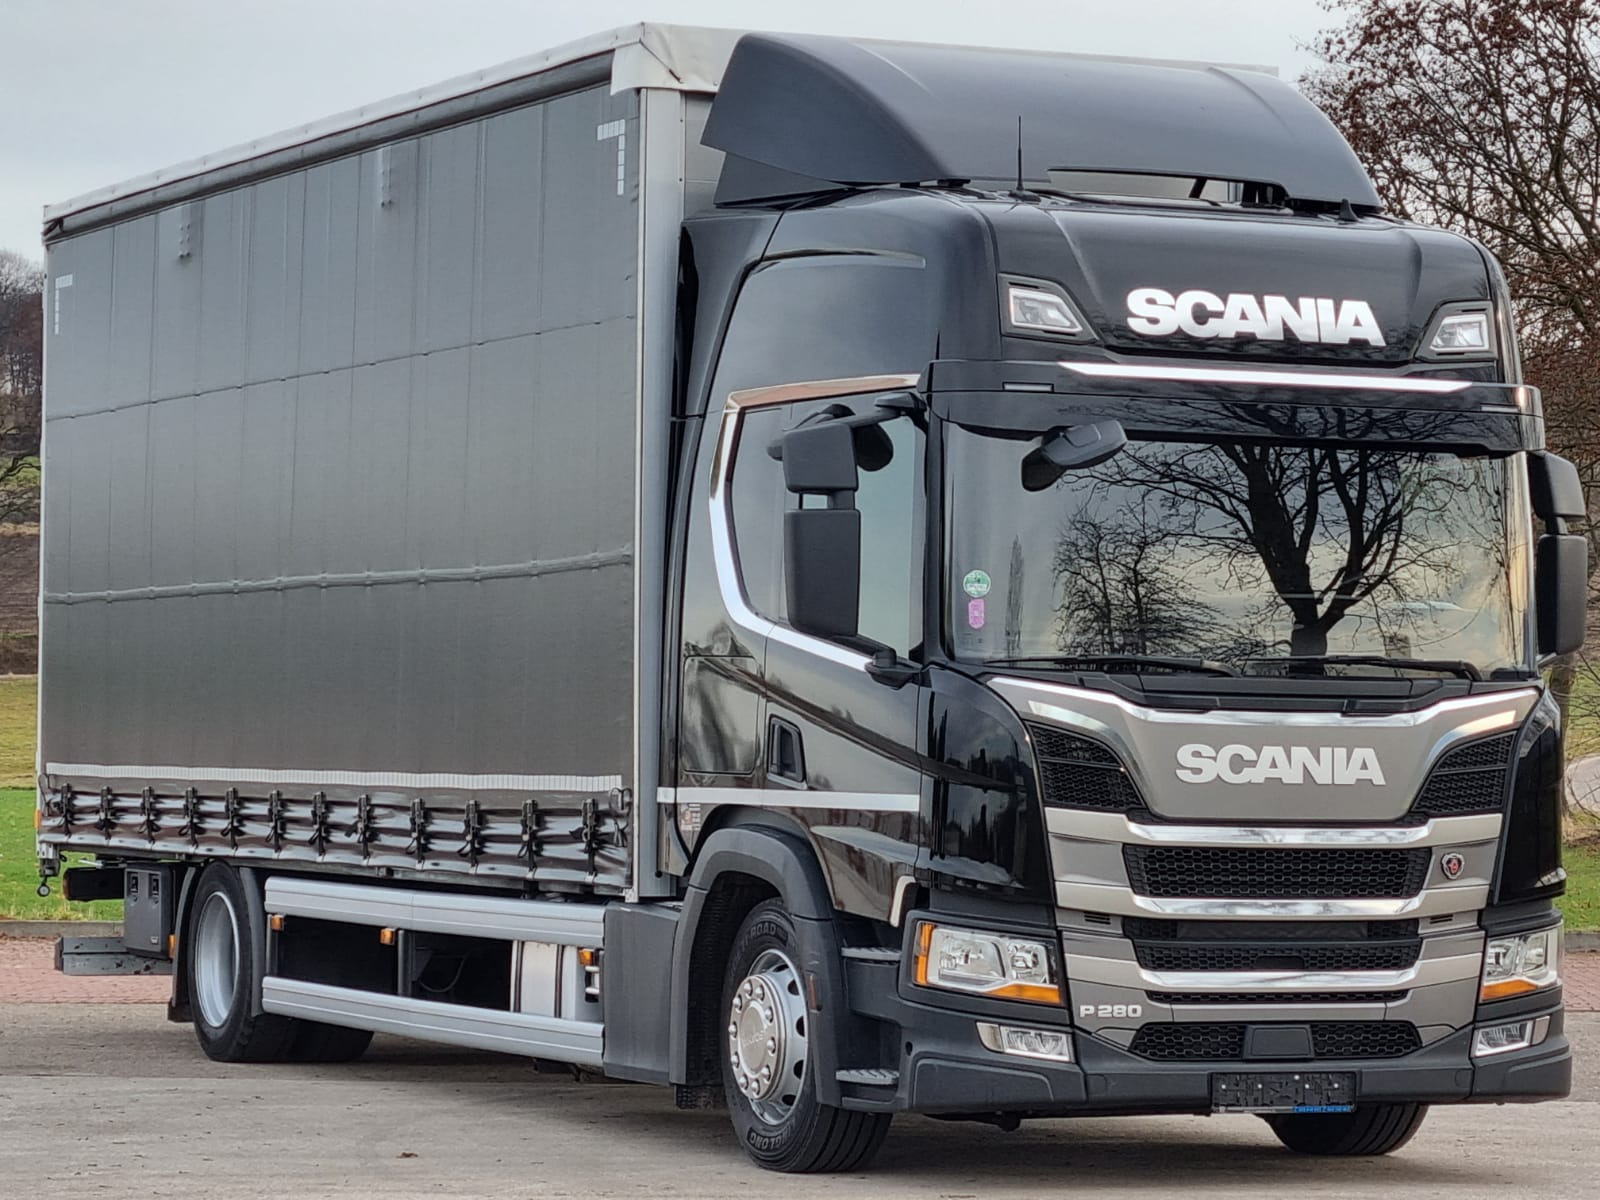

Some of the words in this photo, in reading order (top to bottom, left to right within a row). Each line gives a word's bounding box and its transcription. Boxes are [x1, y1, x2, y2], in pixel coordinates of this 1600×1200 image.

[1126, 288, 1386, 347] SCANIA
[1175, 743, 1386, 785] SCANIA
[1079, 1005, 1095, 1018] P
[1097, 1004, 1142, 1018] 280
